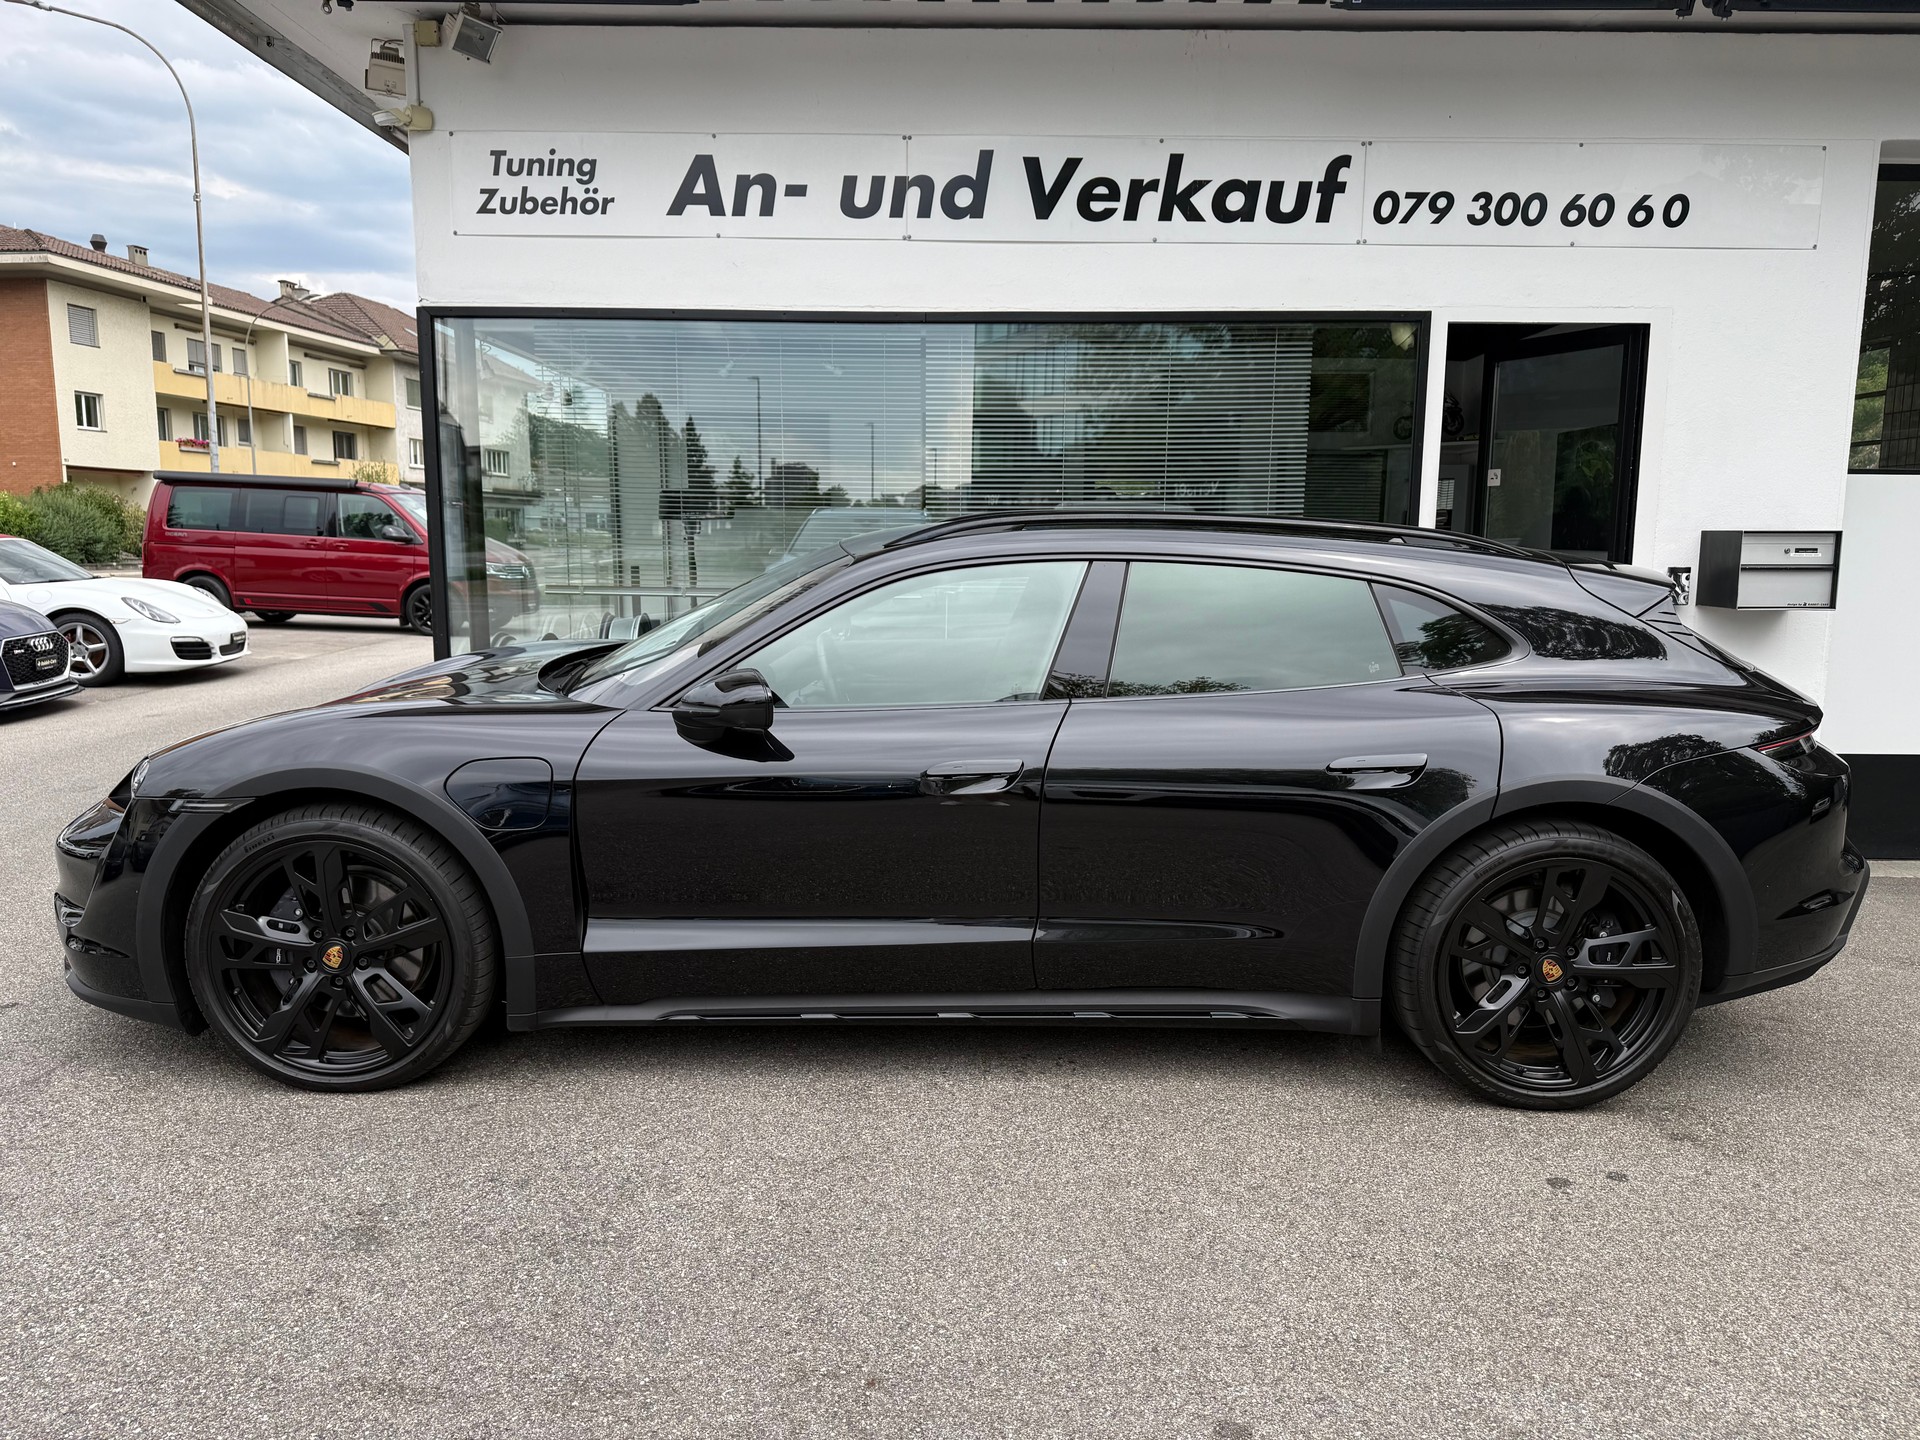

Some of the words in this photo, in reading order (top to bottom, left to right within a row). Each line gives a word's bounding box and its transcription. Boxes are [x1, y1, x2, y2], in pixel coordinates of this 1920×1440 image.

[489, 148, 597, 185] Tuning
[476, 185, 615, 215] Zubehör
[666, 154, 808, 217] An-
[840, 149, 994, 220] und
[1022, 153, 1353, 224] Verkauf
[1373, 190, 1455, 225] 079
[1466, 191, 1548, 227] 300
[1560, 192, 1616, 228] 60
[1628, 193, 1691, 229] 60
